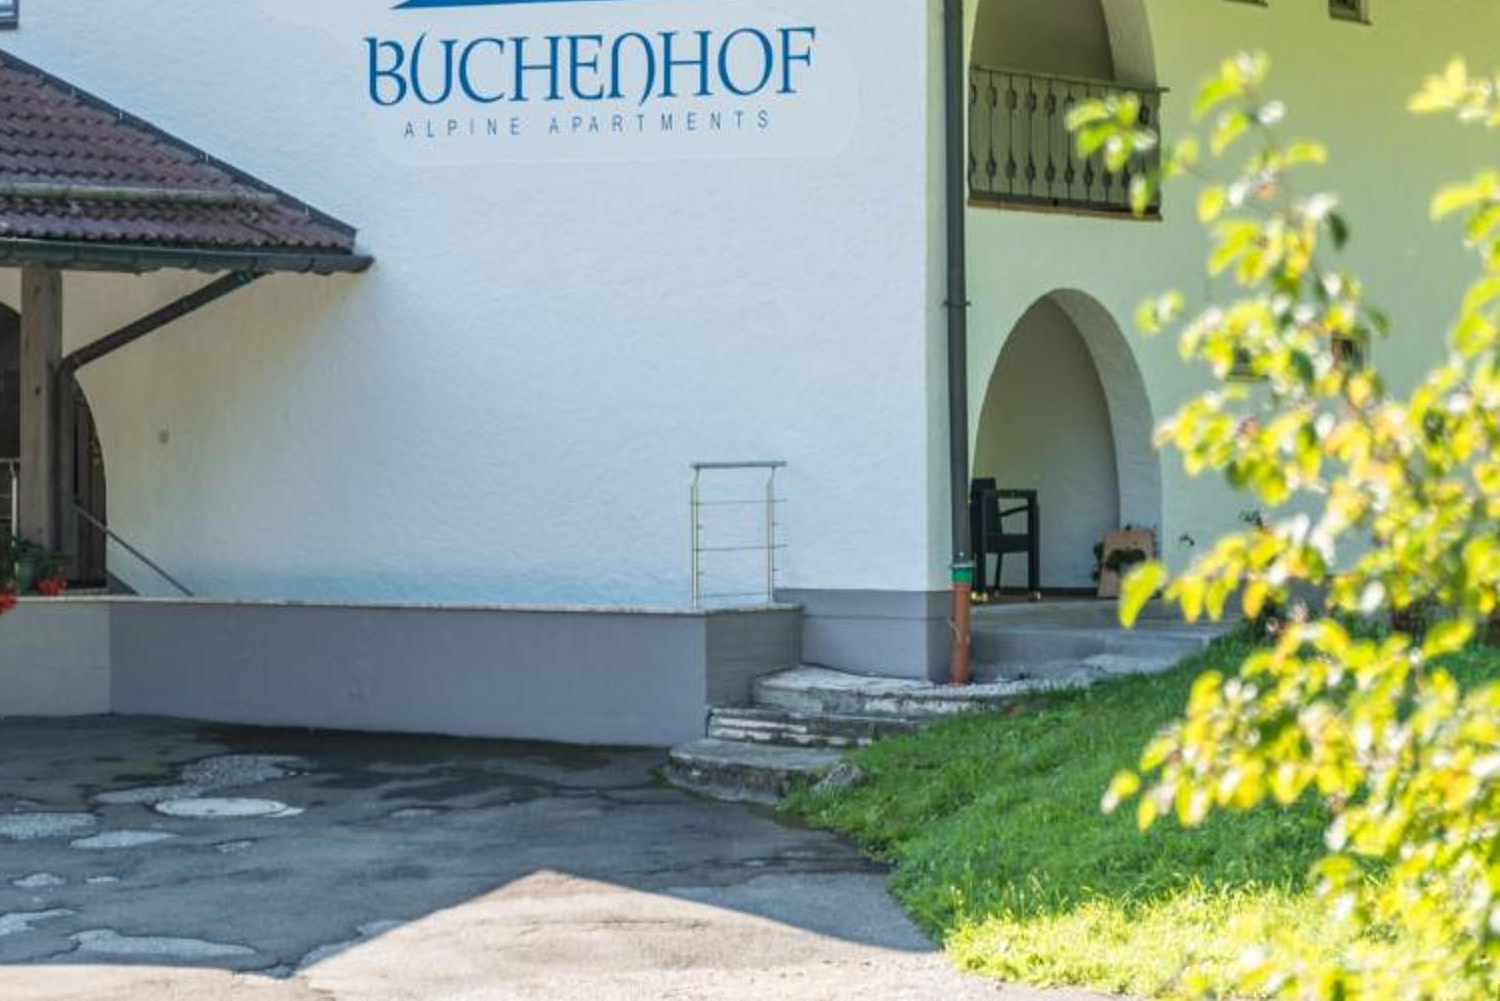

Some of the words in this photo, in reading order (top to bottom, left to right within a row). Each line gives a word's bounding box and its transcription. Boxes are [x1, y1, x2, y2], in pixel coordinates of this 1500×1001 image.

[364, 26, 816, 106] BUCHENHOF
[404, 117, 521, 139] ALPINE
[549, 110, 770, 134] APARTMENTS
